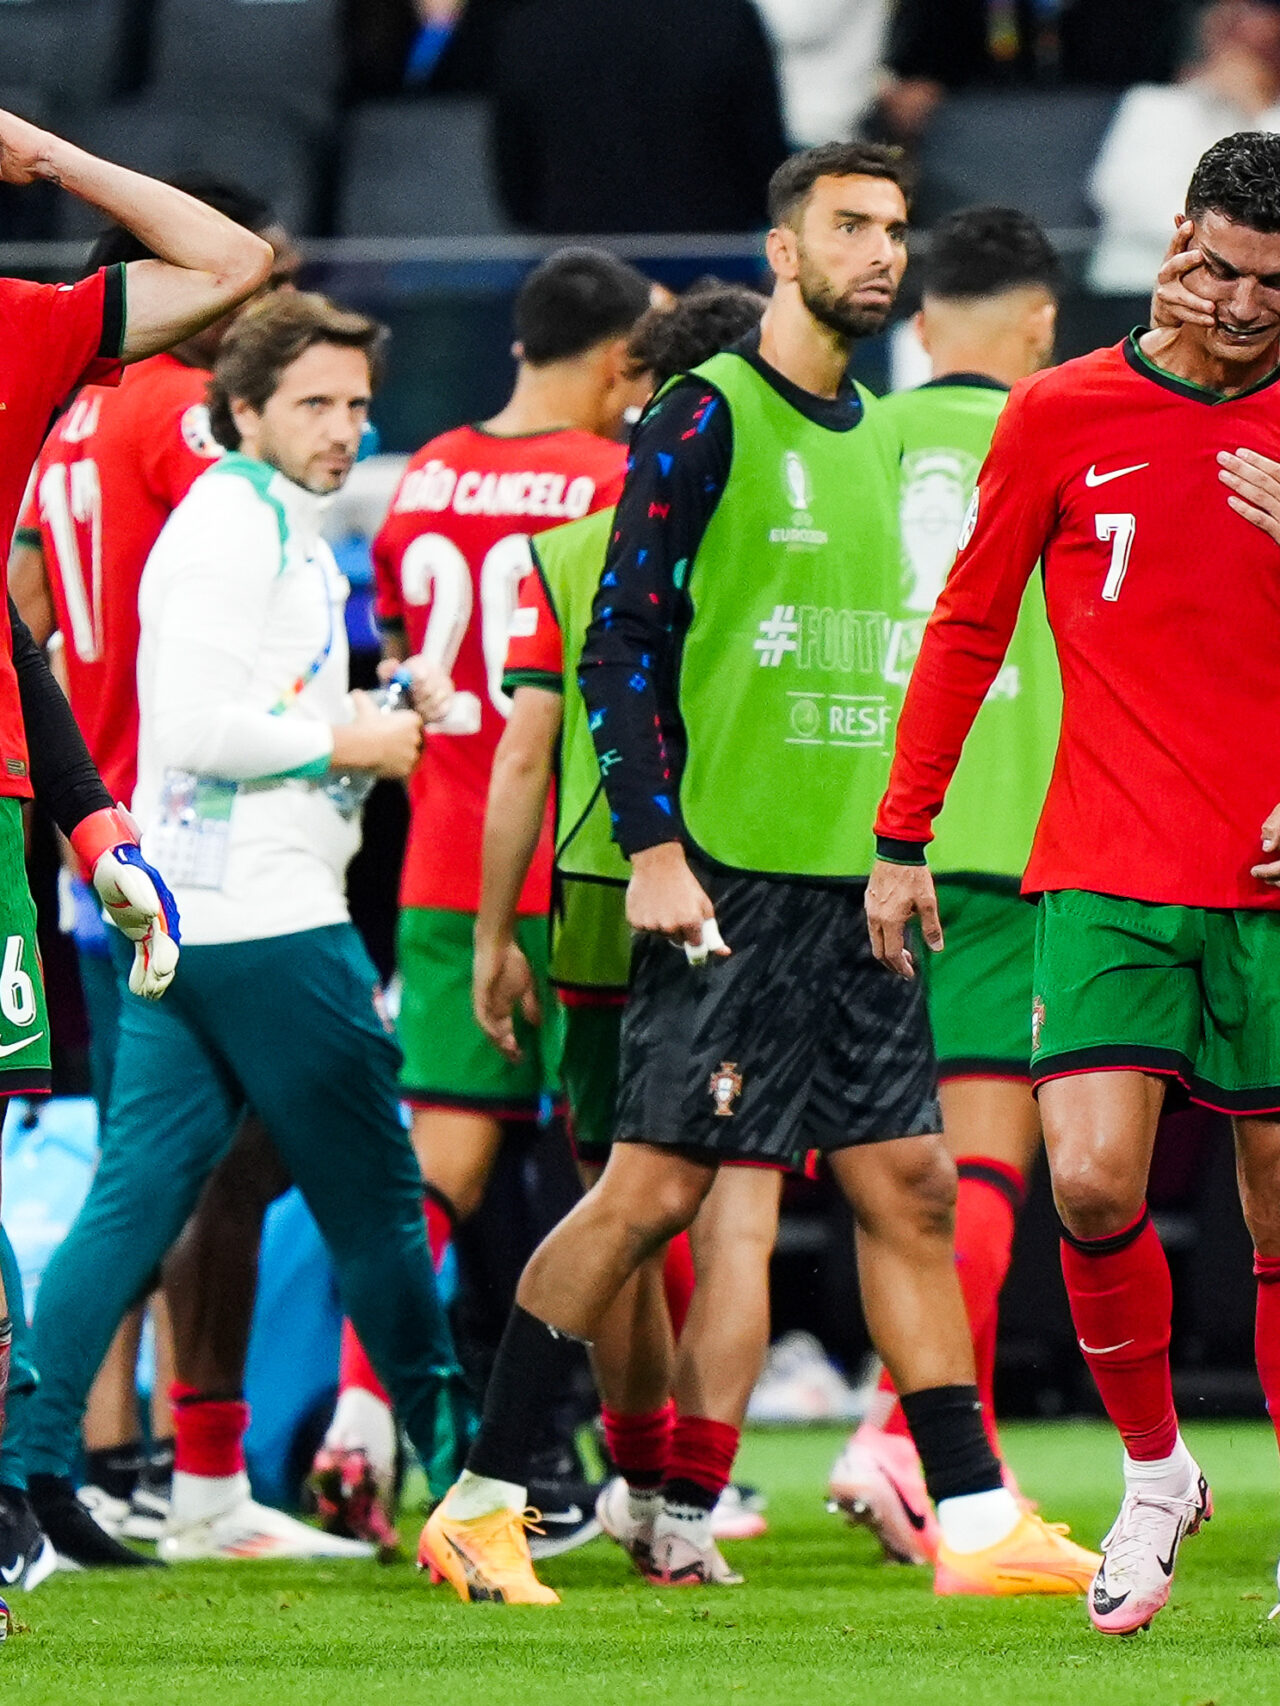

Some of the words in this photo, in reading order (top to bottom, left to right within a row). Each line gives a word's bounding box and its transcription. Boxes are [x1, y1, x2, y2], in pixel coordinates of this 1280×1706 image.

[452, 471, 596, 519] CANCELO
[1095, 513, 1136, 602] 7
[0, 935, 36, 1027] 6
